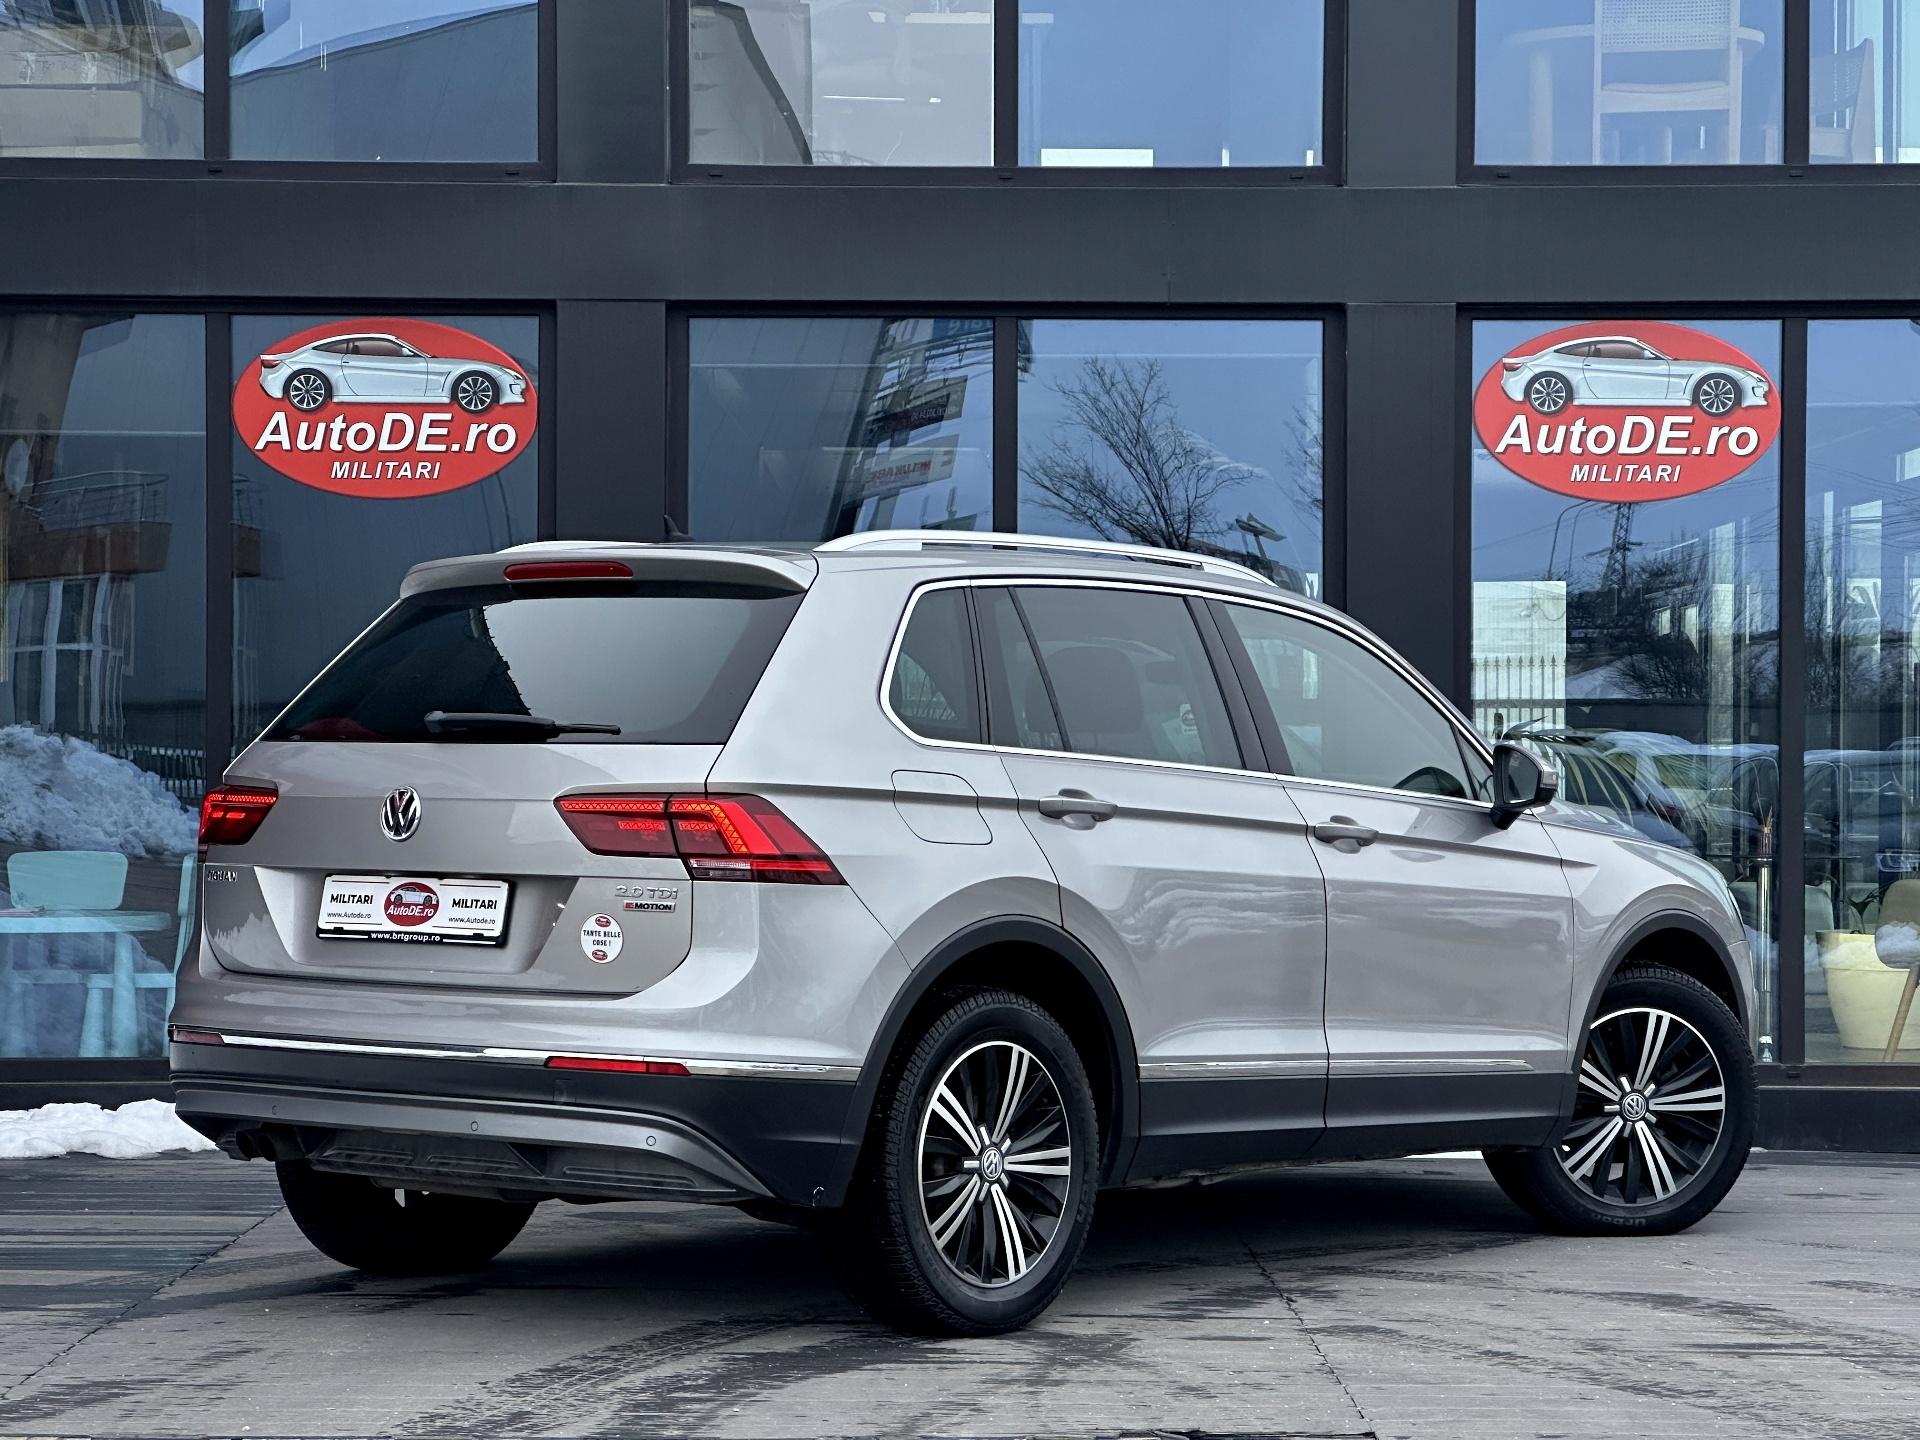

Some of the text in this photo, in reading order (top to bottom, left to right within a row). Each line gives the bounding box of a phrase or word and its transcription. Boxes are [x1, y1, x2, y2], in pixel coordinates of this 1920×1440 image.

[254, 411, 518, 454] AutoDE.ro
[1495, 414, 1760, 457] AutoDE.ro
[331, 461, 440, 479] MILITARI
[1570, 464, 1681, 482] MILITARI
[330, 893, 374, 905] MILITARI
[452, 898, 498, 910] MILITARI
[386, 905, 435, 917] AutoDE.ro
[370, 931, 441, 943] www.brtgroup.ro
[583, 929, 622, 938] TANTE BELLE
[592, 939, 608, 947] COSE
